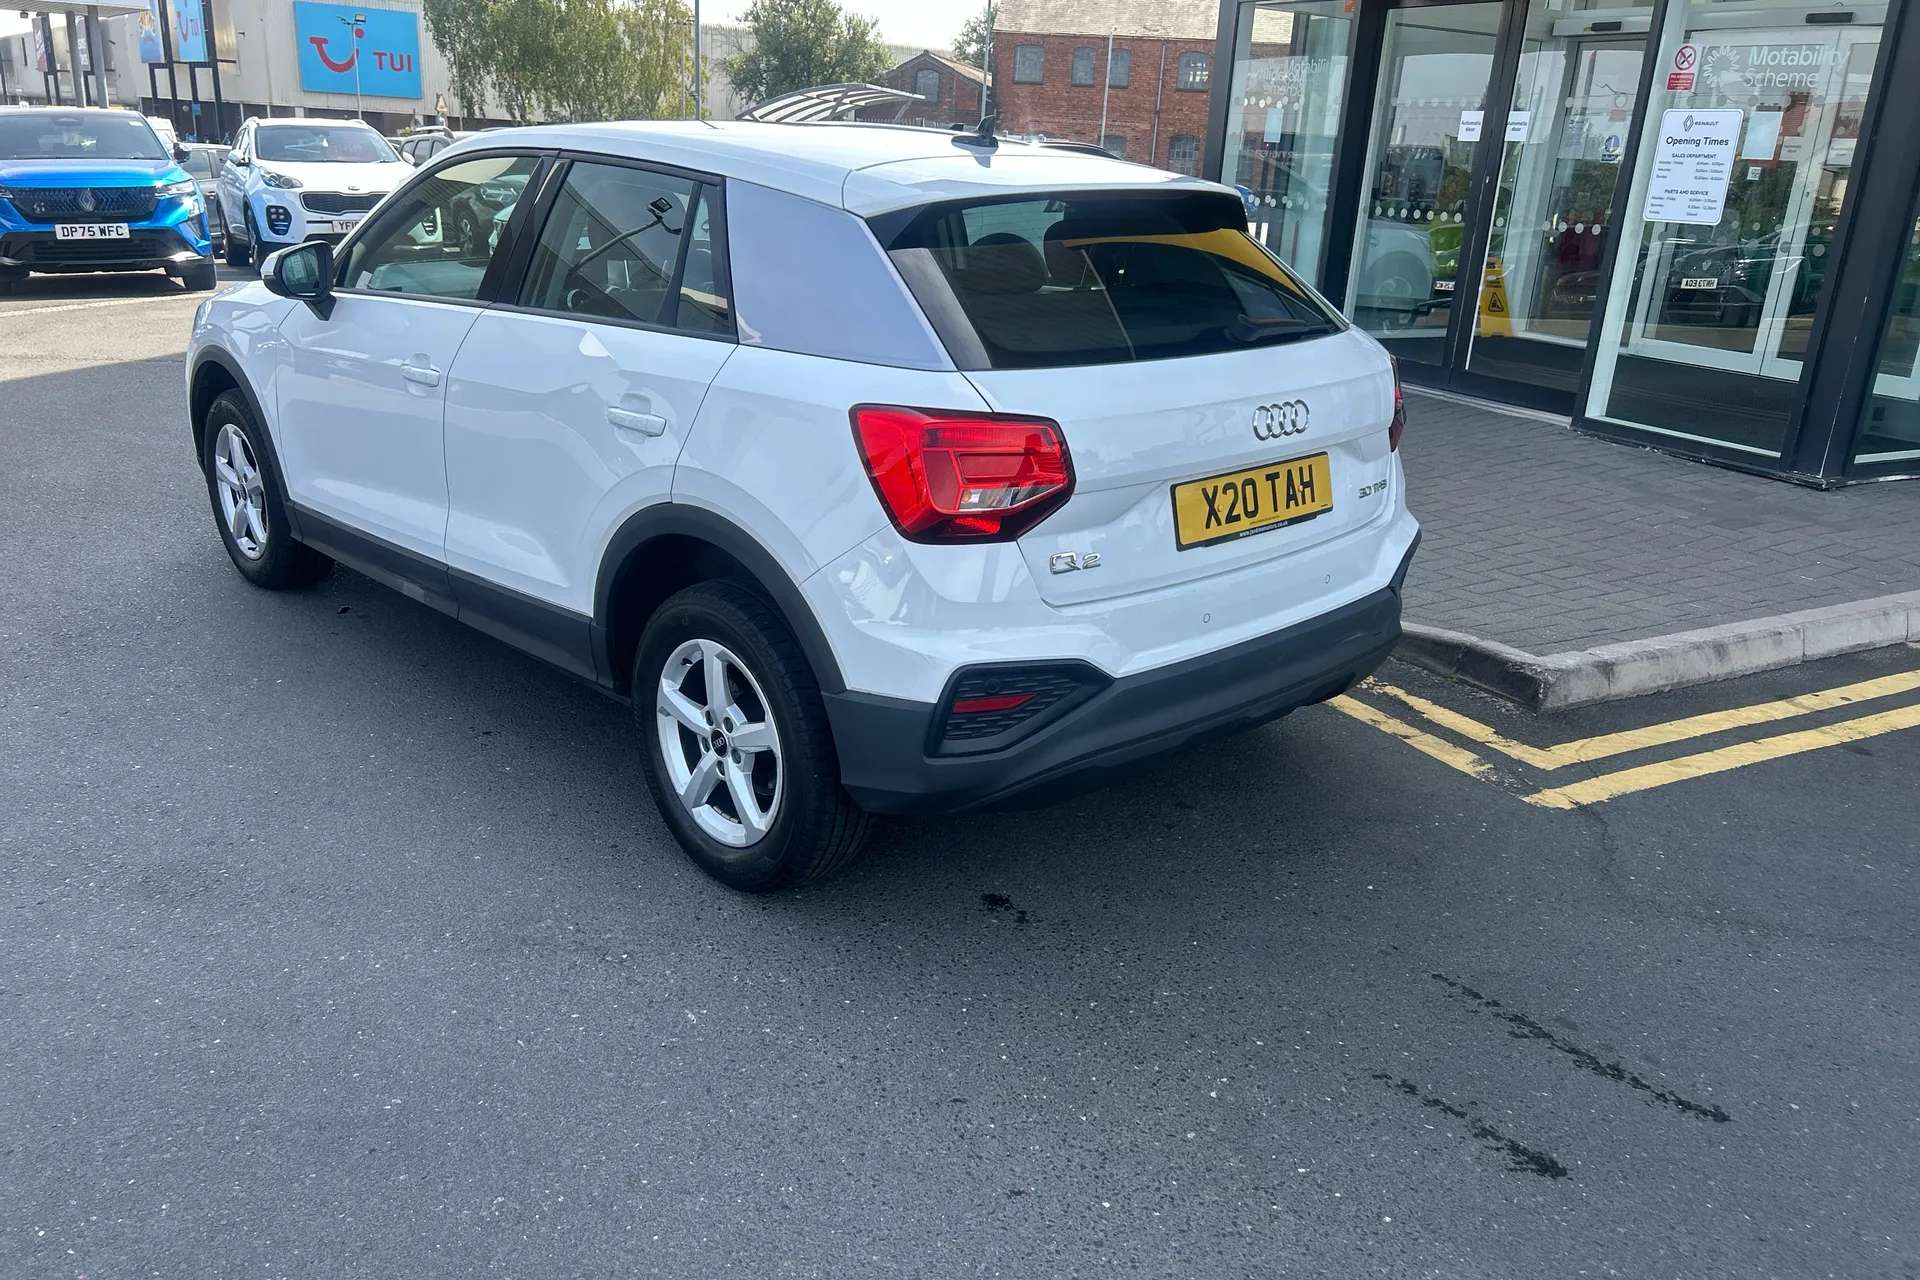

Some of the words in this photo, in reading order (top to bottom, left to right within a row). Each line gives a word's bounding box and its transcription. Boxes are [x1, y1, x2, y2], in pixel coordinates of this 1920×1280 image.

[373, 52, 412, 73] TUI
[1749, 45, 1849, 66] Motability
[1744, 68, 1818, 88] Scheme
[1666, 136, 1701, 147] Opening
[1703, 136, 1729, 146] Times
[61, 226, 96, 237] DP75
[99, 225, 124, 237] WFC
[1201, 477, 1259, 529] X20
[1265, 464, 1316, 513] TAH
[1050, 551, 1101, 574] Q2
